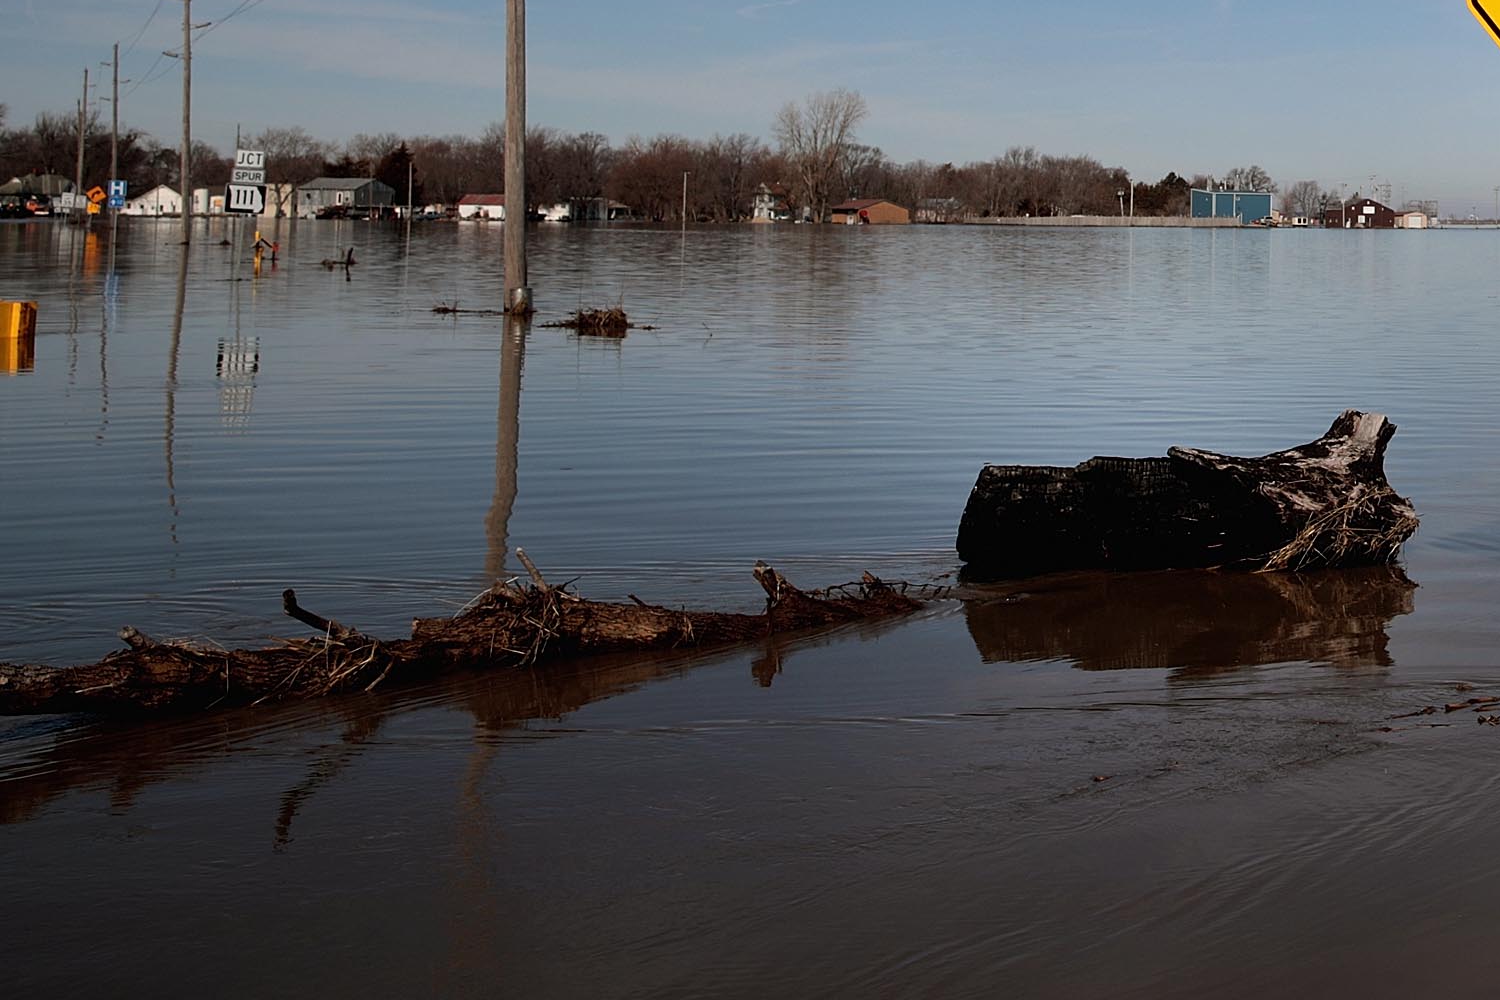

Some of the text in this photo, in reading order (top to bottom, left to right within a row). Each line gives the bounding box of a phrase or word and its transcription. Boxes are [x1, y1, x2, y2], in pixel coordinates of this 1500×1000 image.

[237, 152, 263, 165] JCT
[235, 171, 262, 181] SPUR
[111, 181, 124, 195] H
[236, 189, 254, 205] 111
